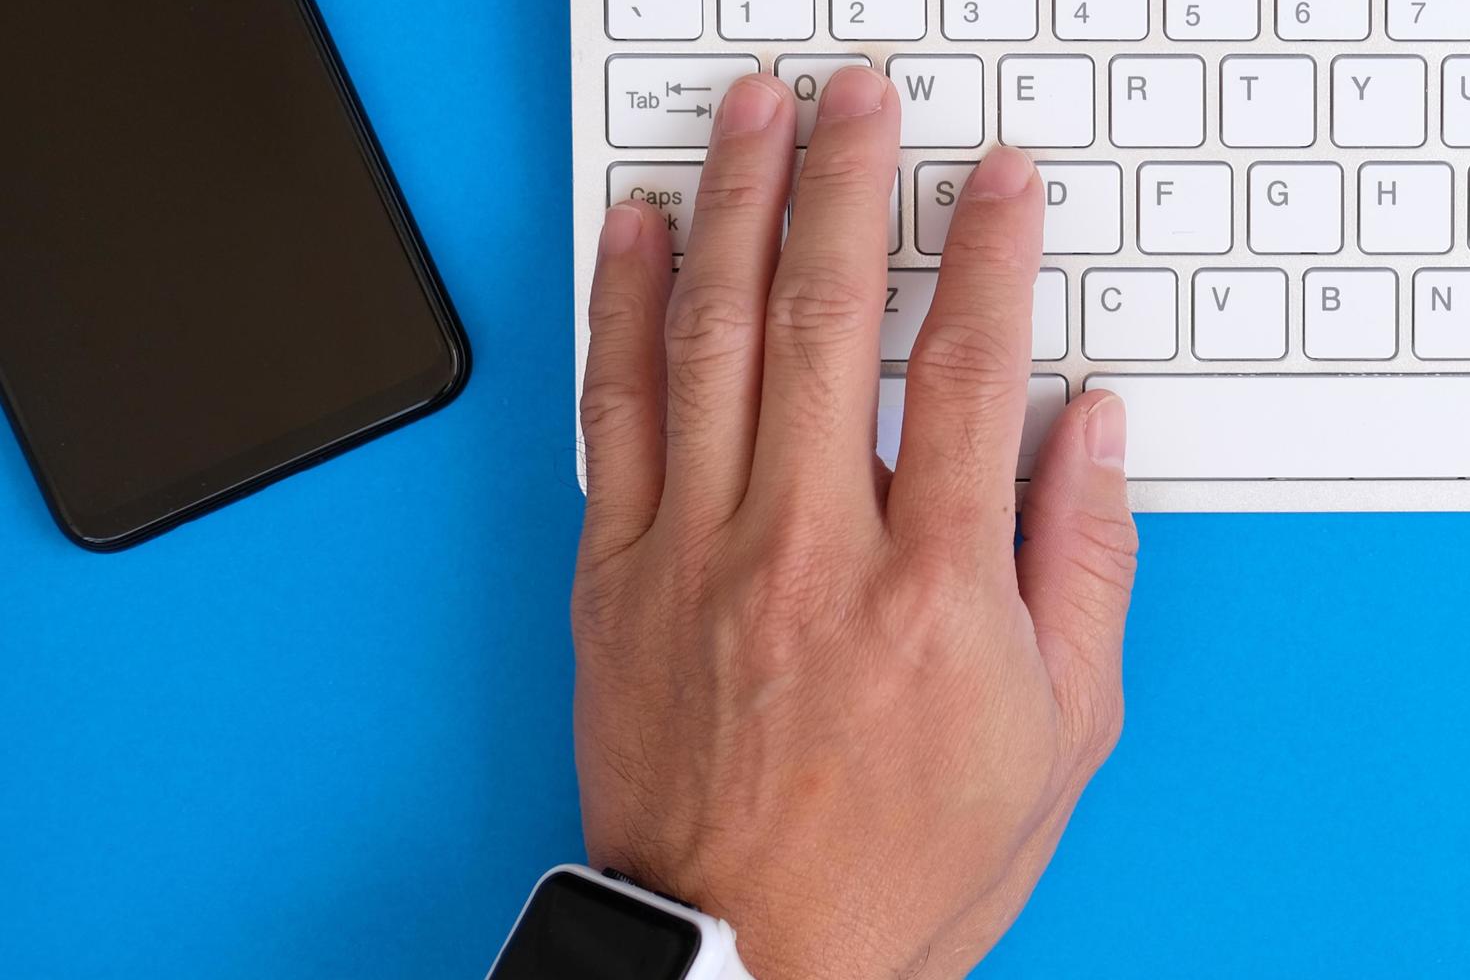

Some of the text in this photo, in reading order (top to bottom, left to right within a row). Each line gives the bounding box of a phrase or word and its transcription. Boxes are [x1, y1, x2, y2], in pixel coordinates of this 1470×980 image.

[740, 1, 750, 22] 1
[850, 2, 864, 23] 2
[964, 2, 979, 23] 3
[1074, 2, 1089, 23] 4
[1186, 5, 1200, 26] 5
[1296, 2, 1310, 23] 6
[1411, 2, 1426, 23] 7
[794, 75, 817, 101] Q
[906, 76, 935, 101] W
[1017, 76, 1035, 101] E
[1128, 76, 1146, 100] R
[1240, 76, 1259, 100] T
[1352, 76, 1371, 100] Y
[626, 92, 659, 109] Tab
[631, 187, 682, 208] Caps
[936, 181, 955, 206] S
[1047, 181, 1067, 206] D
[1157, 181, 1174, 205] F
[1267, 180, 1288, 206] G
[1378, 181, 1396, 205] H
[884, 287, 898, 313] Z
[1101, 287, 1122, 312] C
[1212, 287, 1230, 311] V
[1322, 287, 1340, 311] B
[1432, 287, 1451, 311] N
